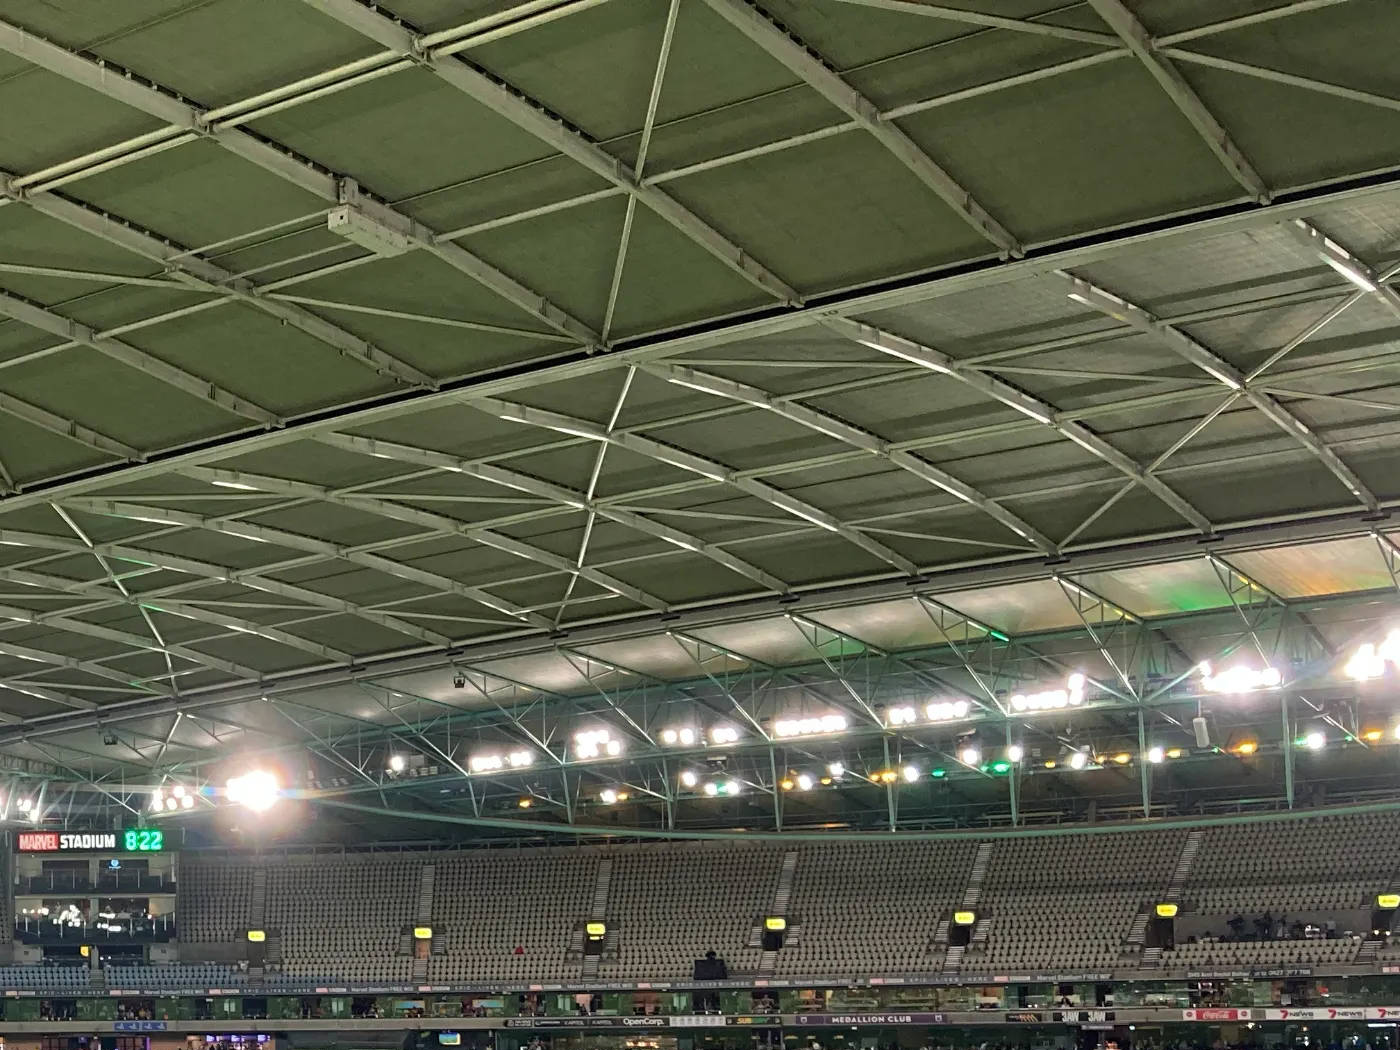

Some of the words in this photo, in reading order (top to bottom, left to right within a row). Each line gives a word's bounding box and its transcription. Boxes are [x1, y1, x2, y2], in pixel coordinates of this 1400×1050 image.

[20, 834, 58, 850] MARVEL
[60, 834, 115, 849] STADIUM
[125, 831, 162, 850] 8:22
[623, 1018, 664, 1026] OpenCorp.
[1061, 1011, 1079, 1022] 3AW
[1088, 1011, 1106, 1022] 3AW
